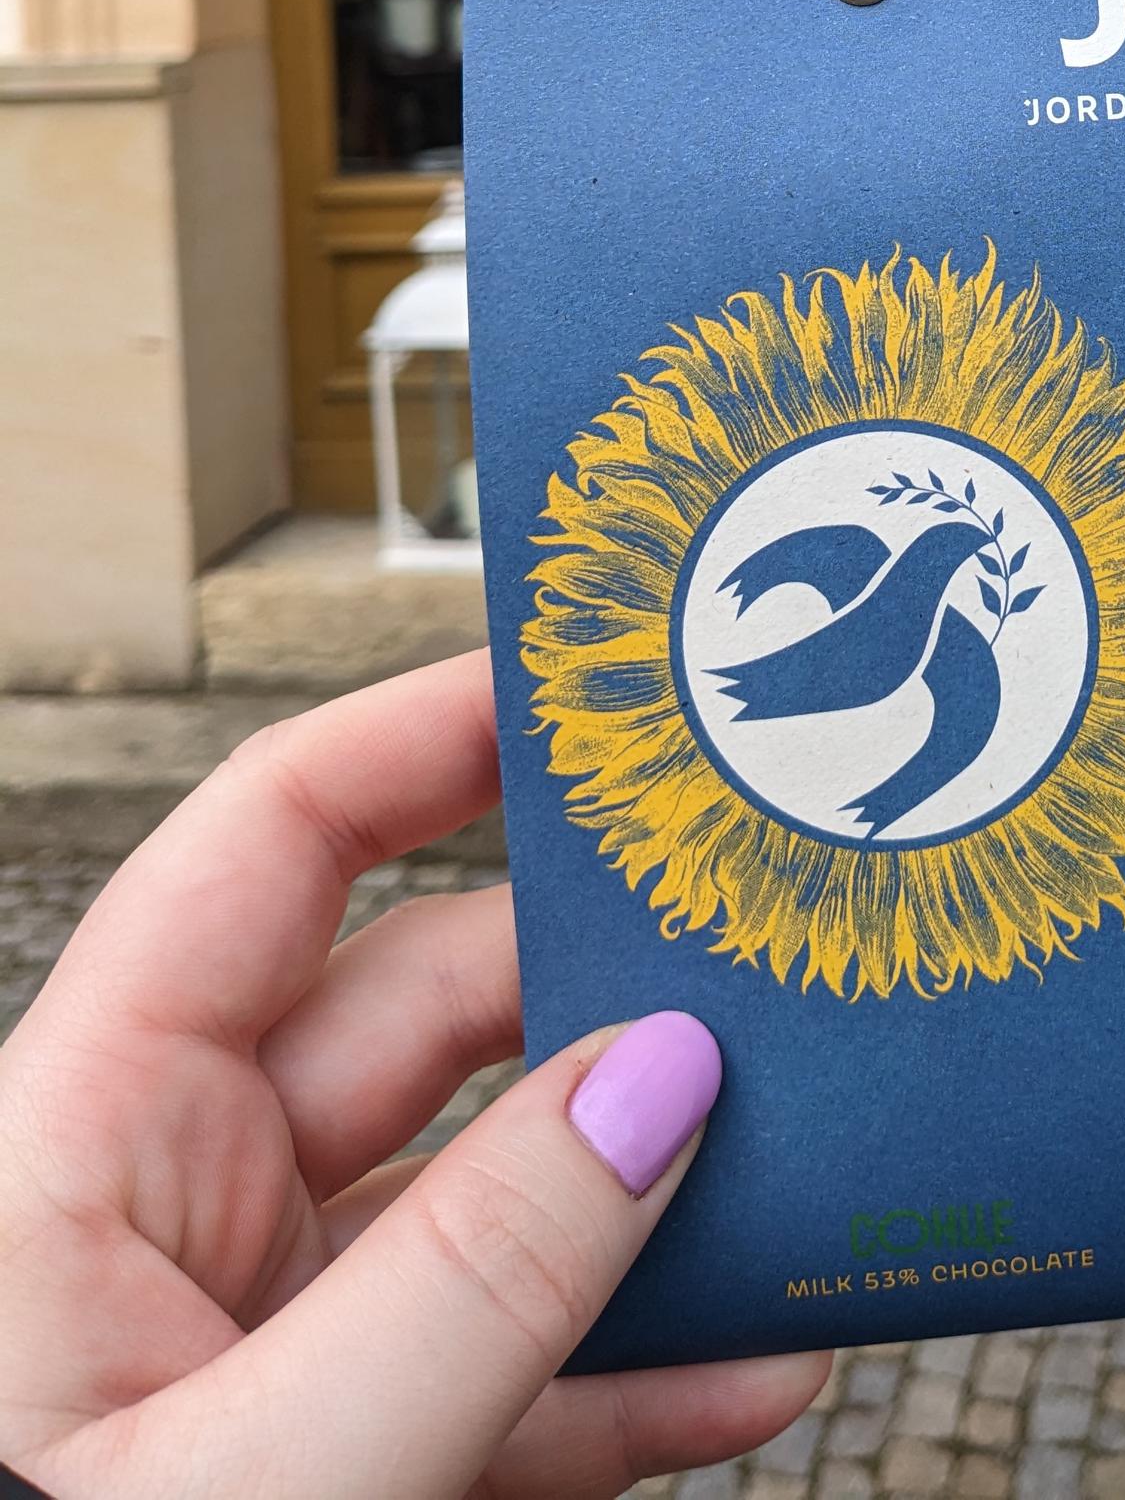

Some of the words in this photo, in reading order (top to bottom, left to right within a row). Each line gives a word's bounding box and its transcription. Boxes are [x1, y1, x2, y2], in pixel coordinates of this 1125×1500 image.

[786, 1273, 853, 1298] MILK
[863, 1267, 920, 1290] 53%
[931, 1248, 1095, 1283] CHOCOLATE
